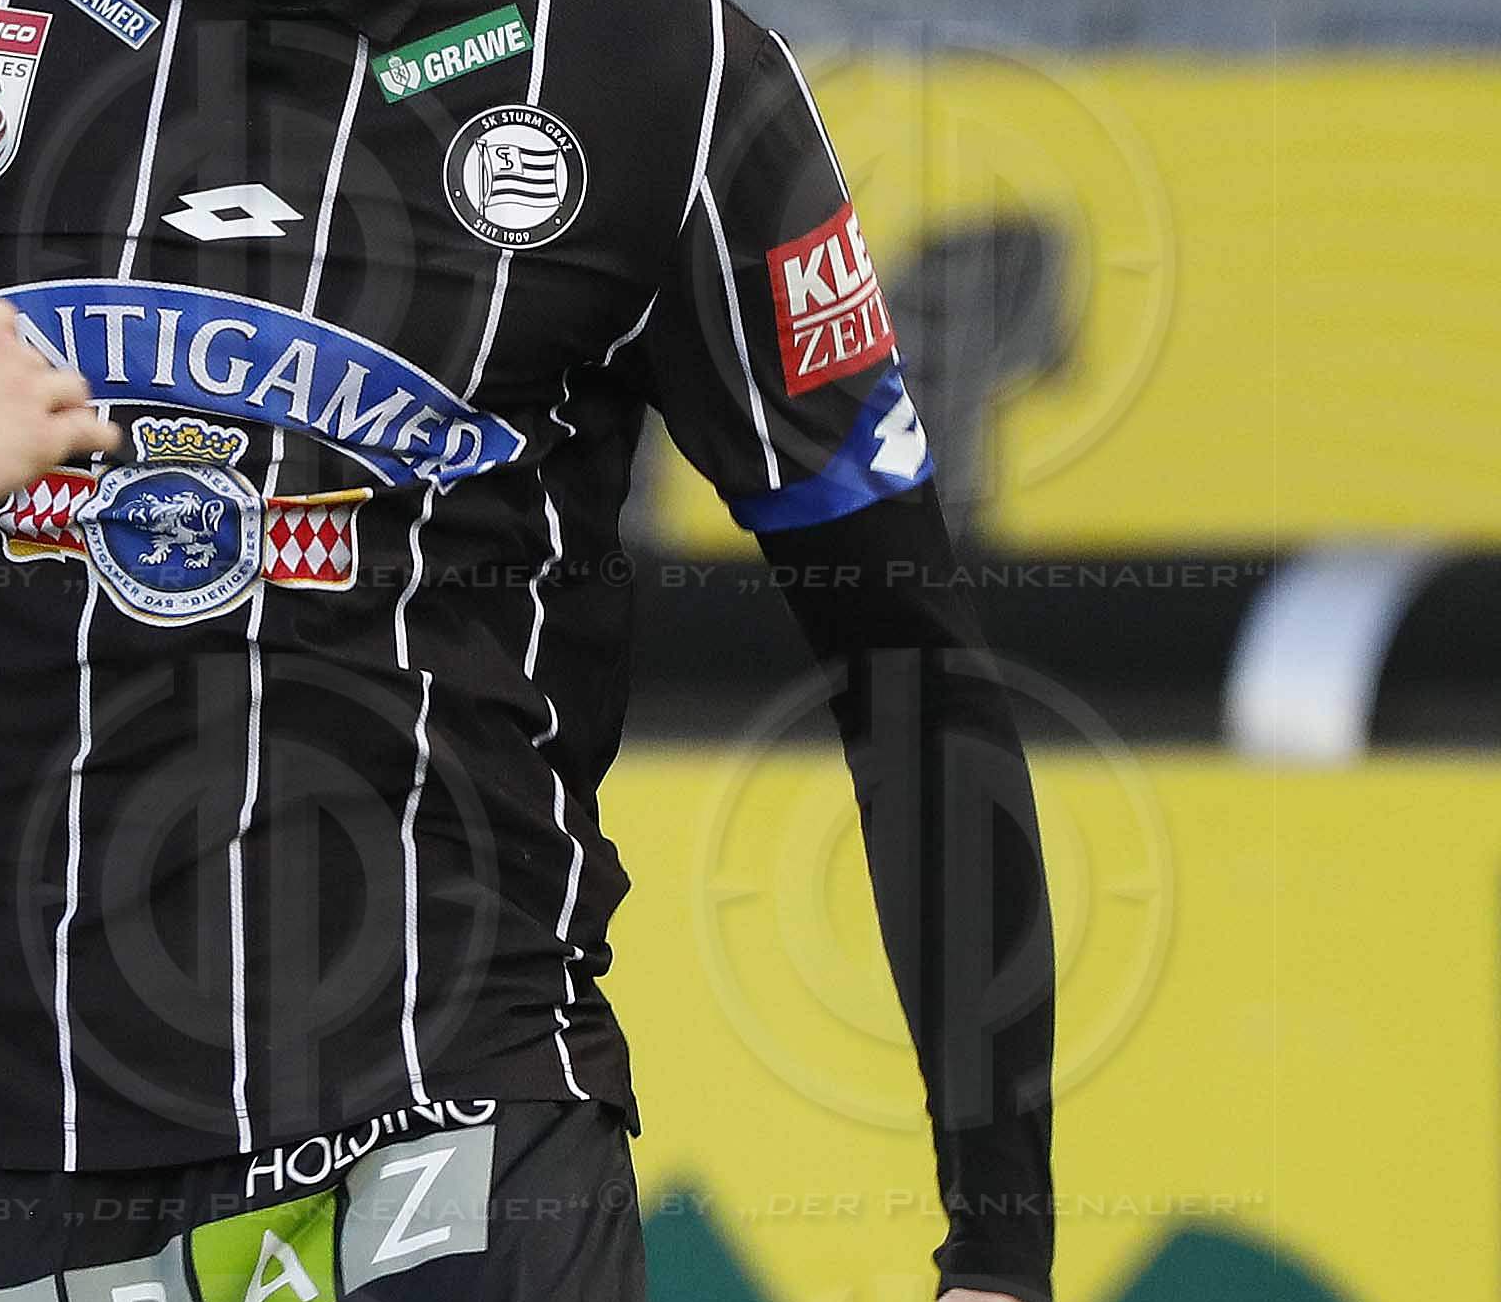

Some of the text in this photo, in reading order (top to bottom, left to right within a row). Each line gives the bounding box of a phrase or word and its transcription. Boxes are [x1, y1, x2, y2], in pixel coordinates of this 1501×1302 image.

[424, 20, 527, 79] GRAWE
[481, 111, 574, 153] SK STURM GRAZ
[473, 218, 531, 244] SEIT 1909
